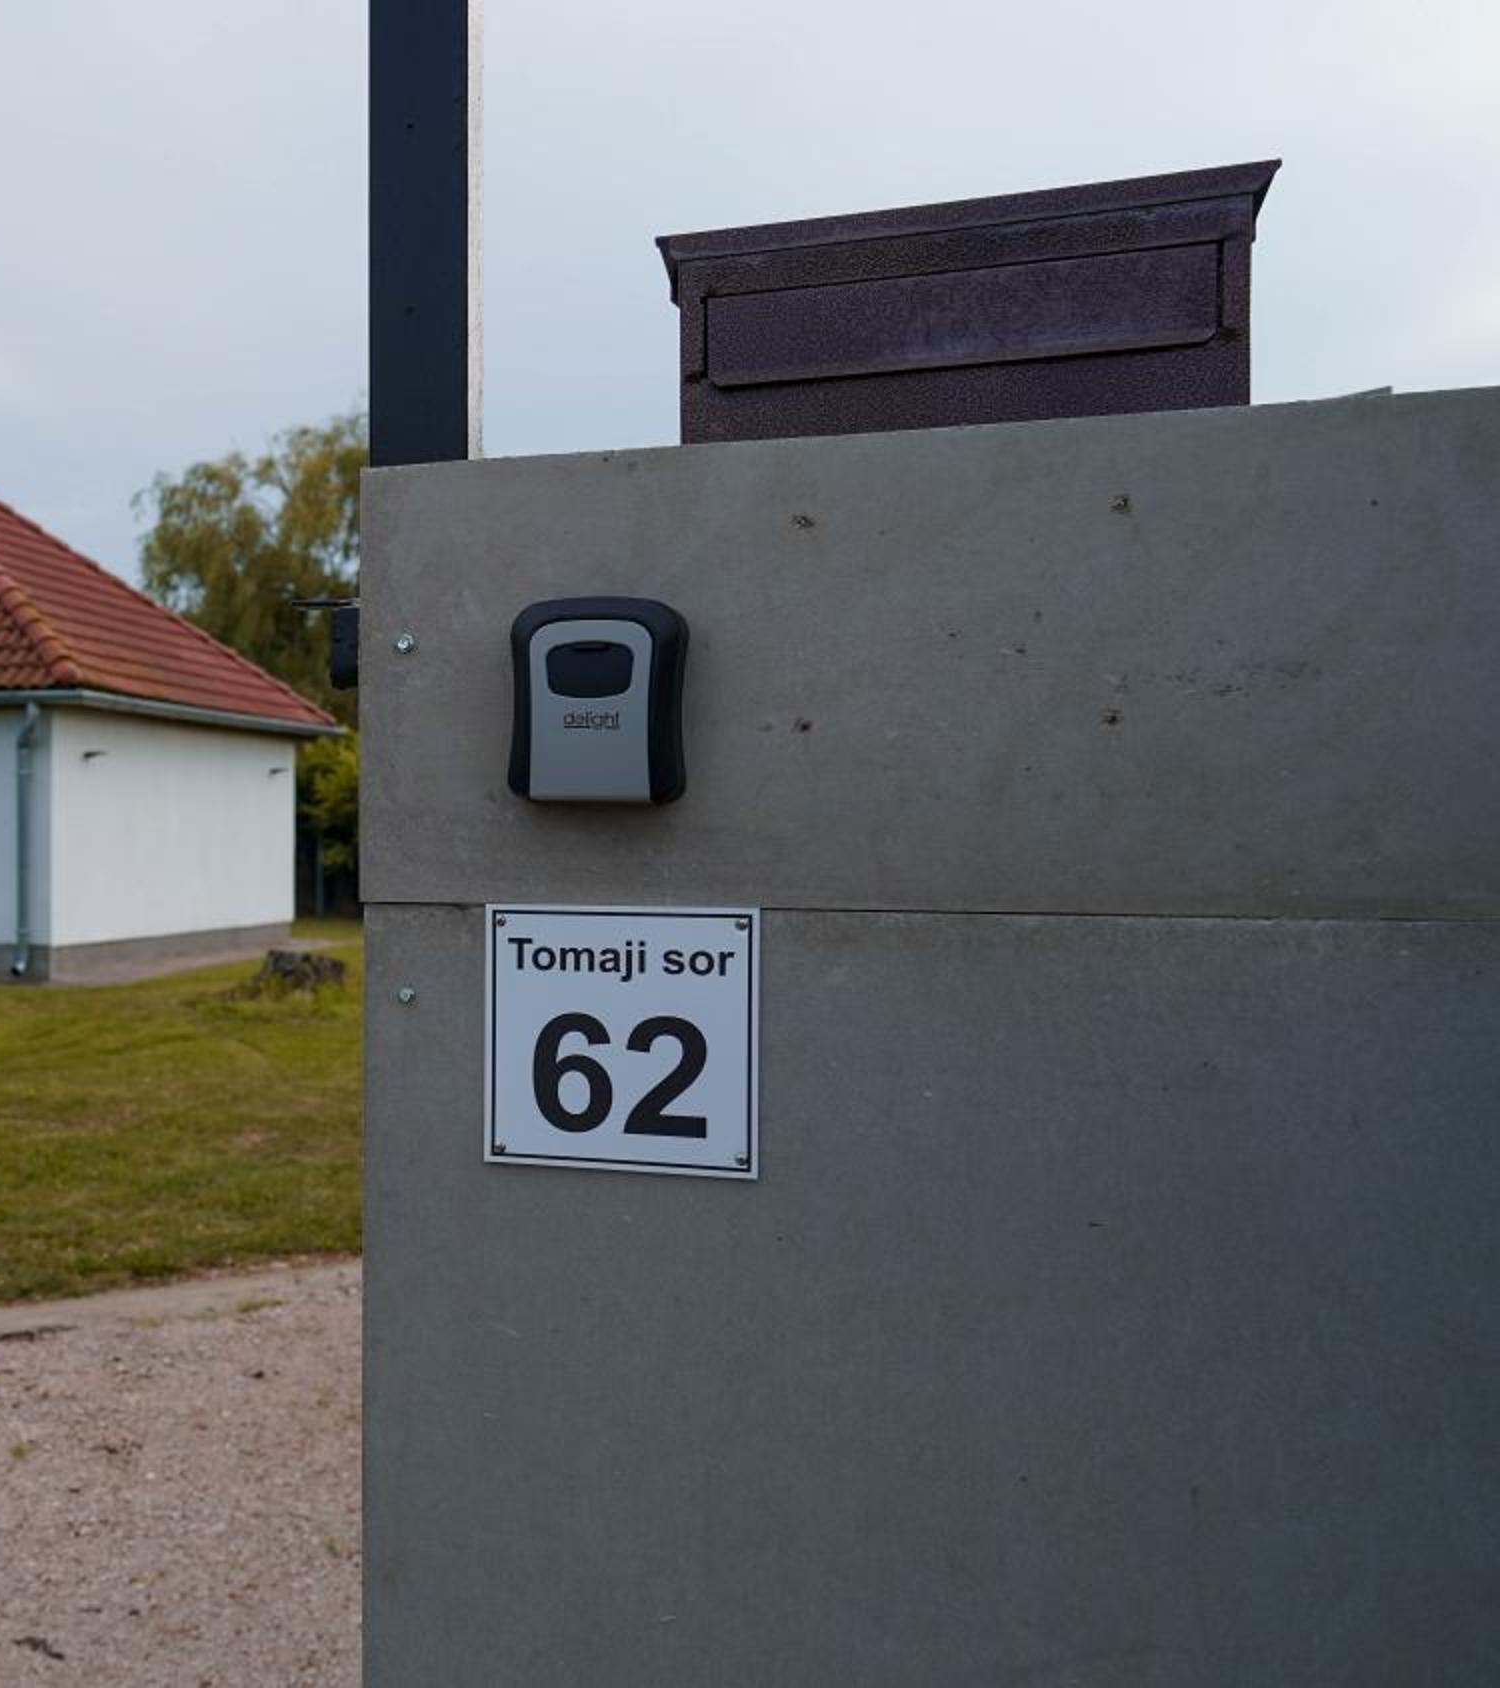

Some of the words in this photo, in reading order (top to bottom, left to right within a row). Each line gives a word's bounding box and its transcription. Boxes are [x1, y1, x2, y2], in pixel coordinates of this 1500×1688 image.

[508, 937, 646, 982] Tomaji
[662, 950, 736, 976] sor
[533, 1012, 708, 1139] 62
